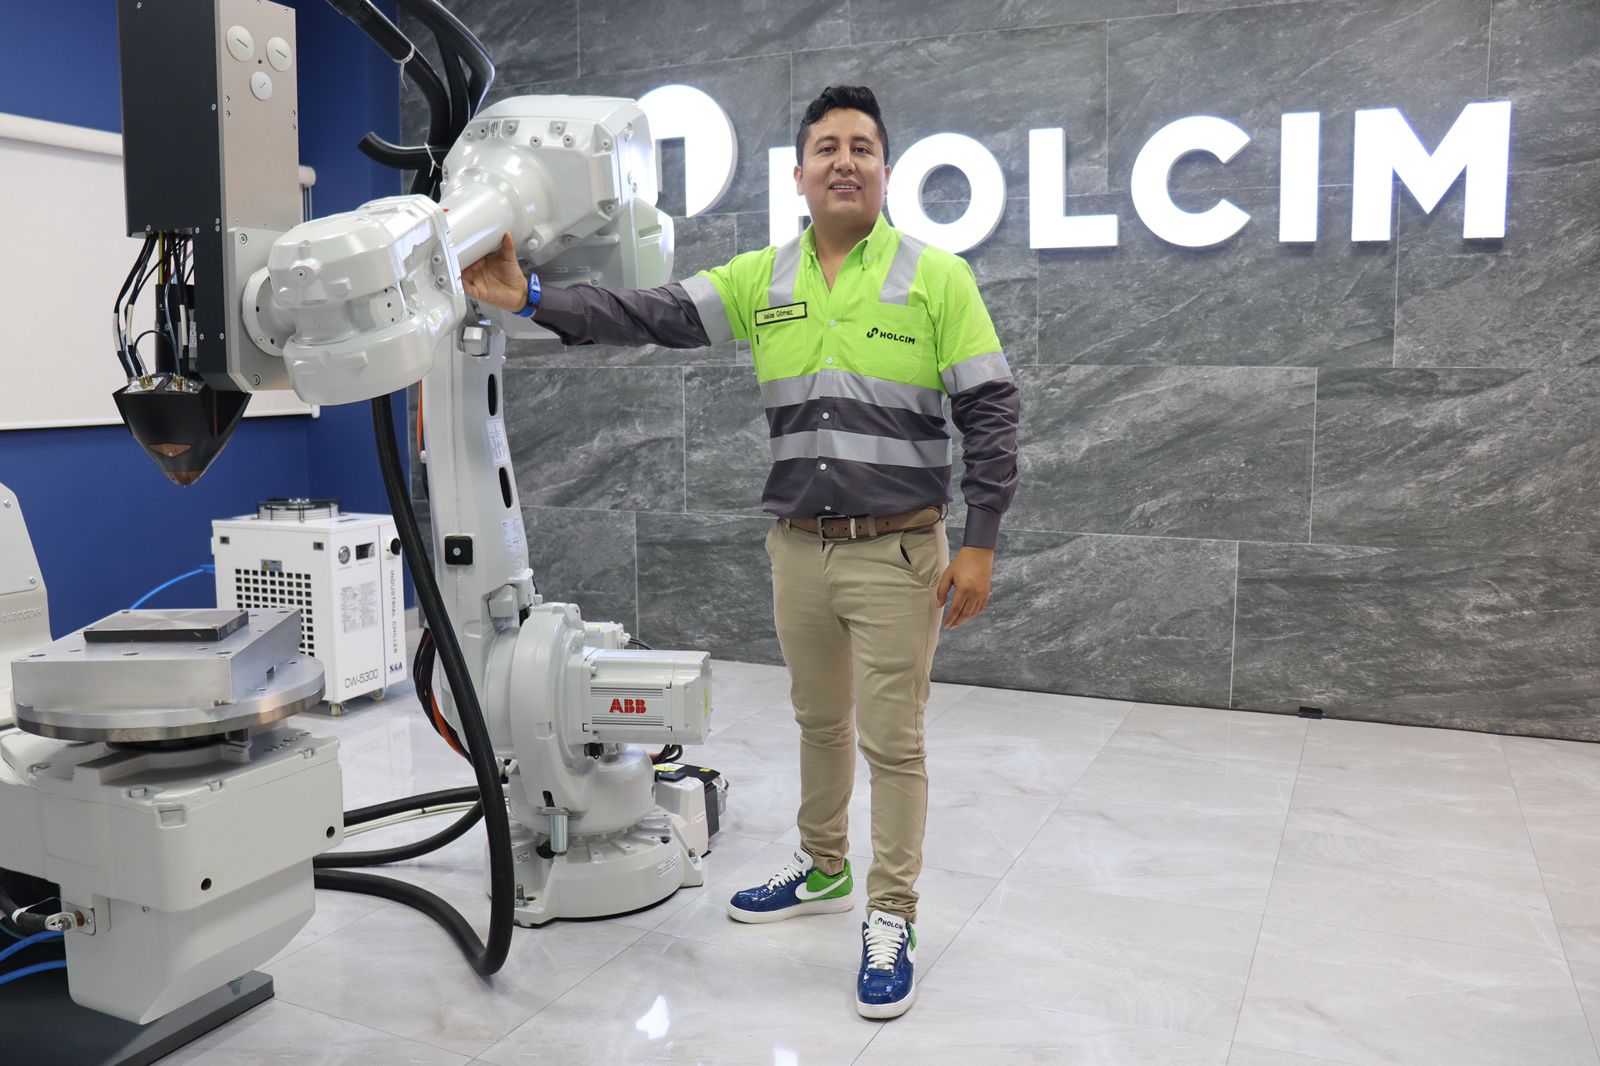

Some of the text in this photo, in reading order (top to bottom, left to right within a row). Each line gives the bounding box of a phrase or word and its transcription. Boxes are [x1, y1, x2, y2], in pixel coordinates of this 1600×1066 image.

[880, 331, 915, 344] HOLCIM
[344, 669, 379, 689] CW-5300
[609, 698, 647, 714] ABB
